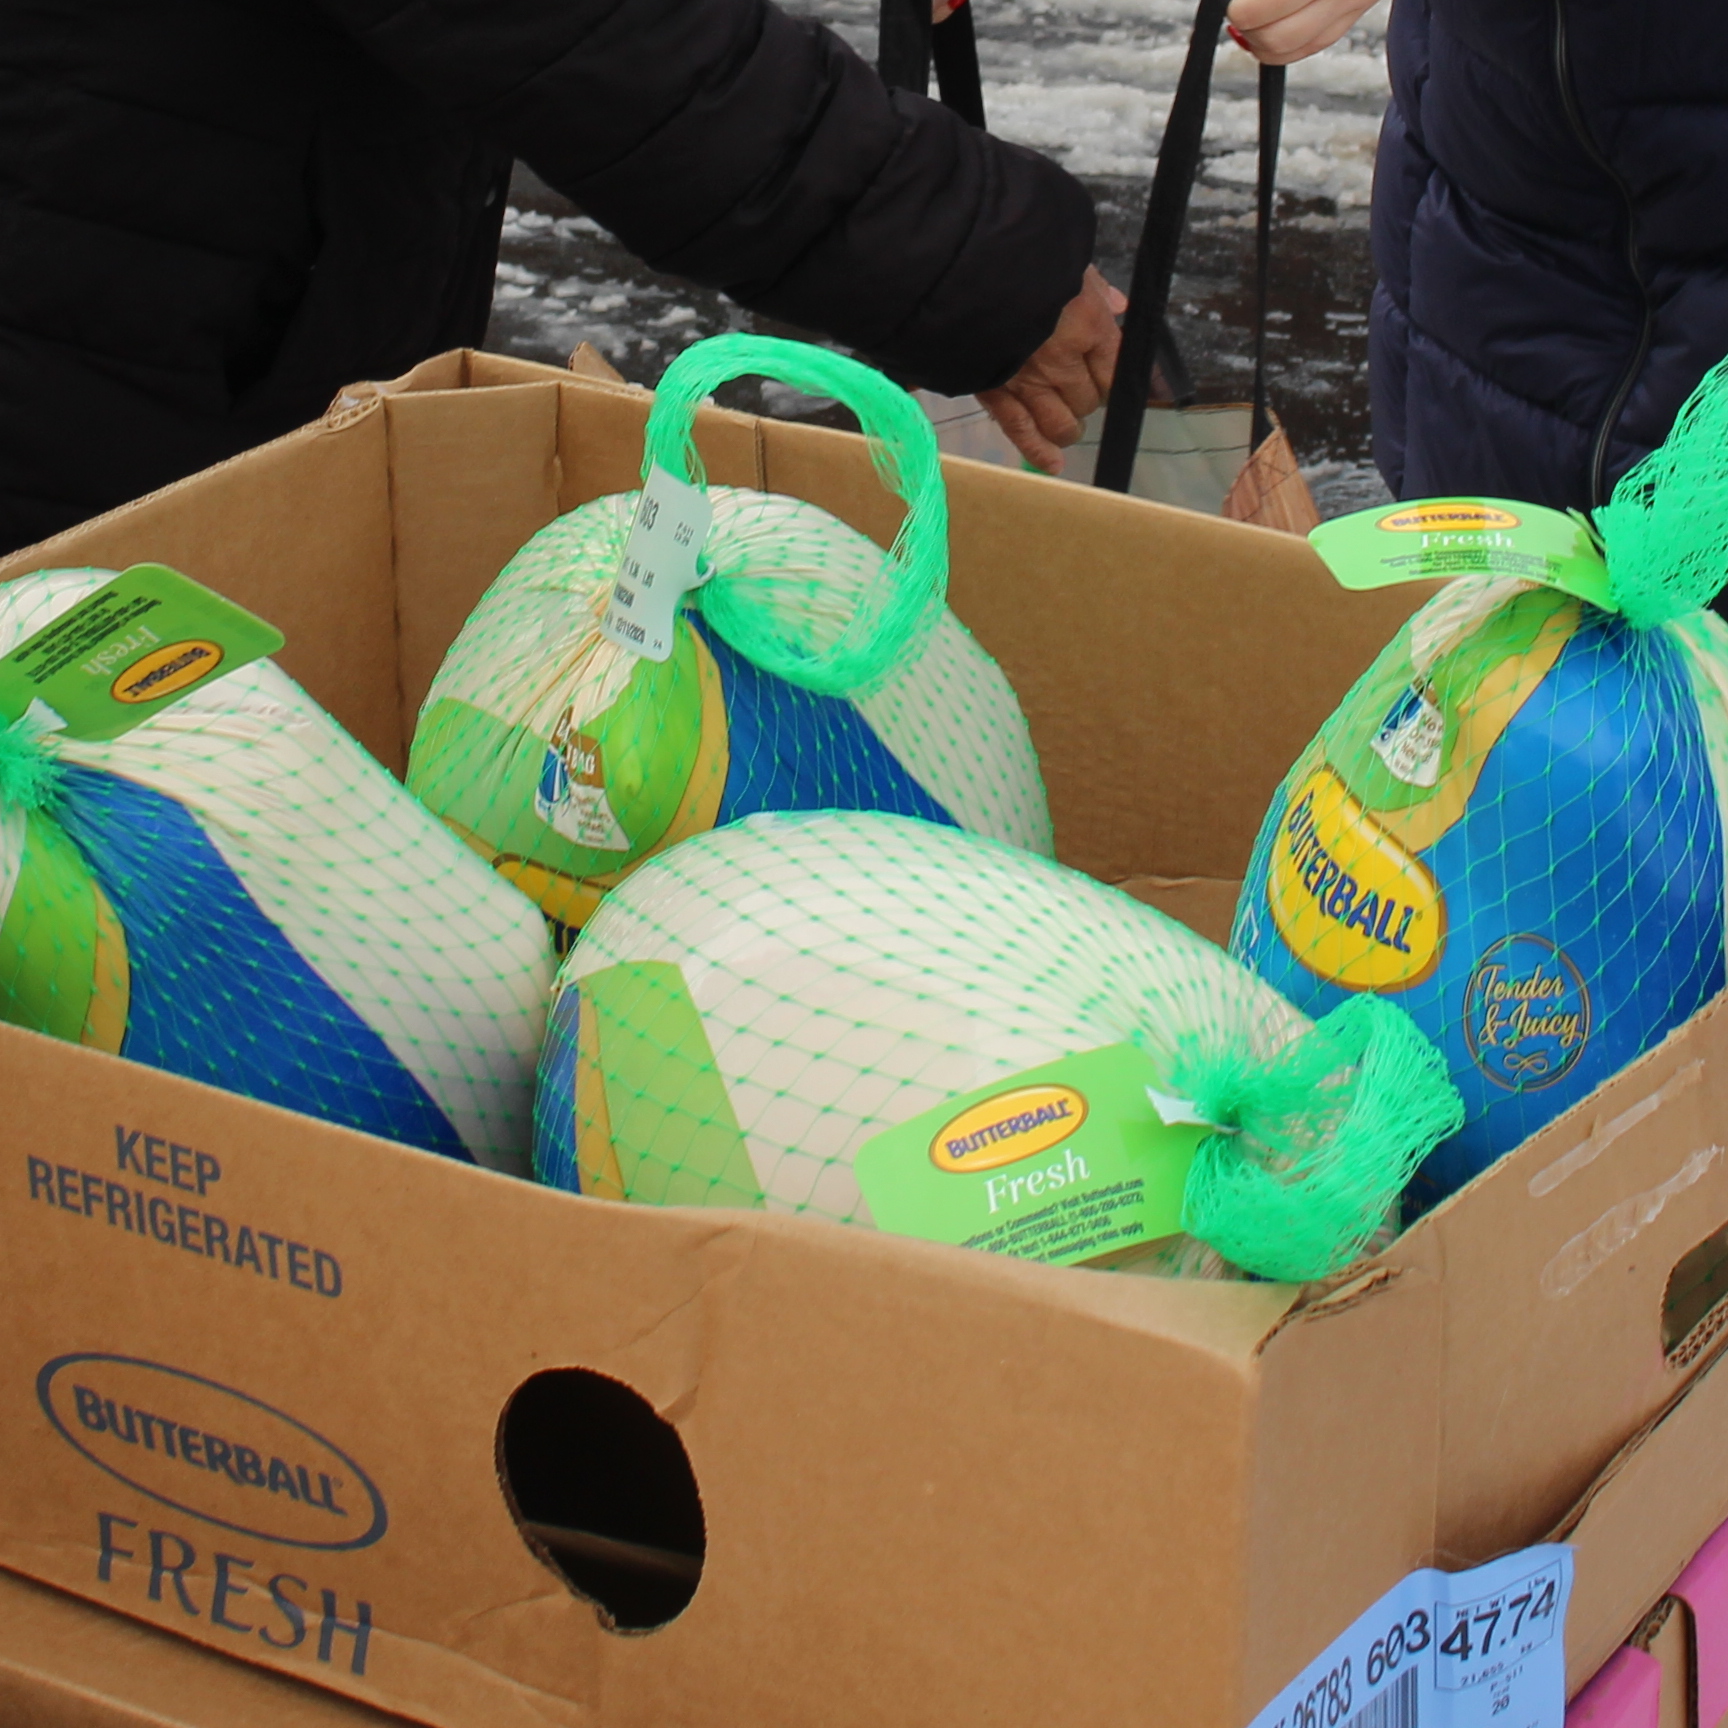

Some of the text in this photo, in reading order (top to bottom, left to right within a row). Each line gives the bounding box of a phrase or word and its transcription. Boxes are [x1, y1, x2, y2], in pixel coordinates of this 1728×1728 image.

[80, 625, 162, 676] Fresh
[1288, 788, 1411, 954] BUTTERBALL
[1476, 963, 1564, 1004] Tender
[1479, 1002, 1584, 1048] & Juicy
[114, 1124, 221, 1198] KEEP
[945, 1098, 1073, 1159] BUTTERBALL
[985, 1148, 1091, 1214] Fresh
[26, 1155, 343, 1299] REFRIGERATED
[73, 1384, 347, 1517] BUTTERBALL
[96, 1511, 372, 1676] FRESH
[1440, 1579, 1555, 1661] 47.74
[1366, 1608, 1431, 1686] 603
